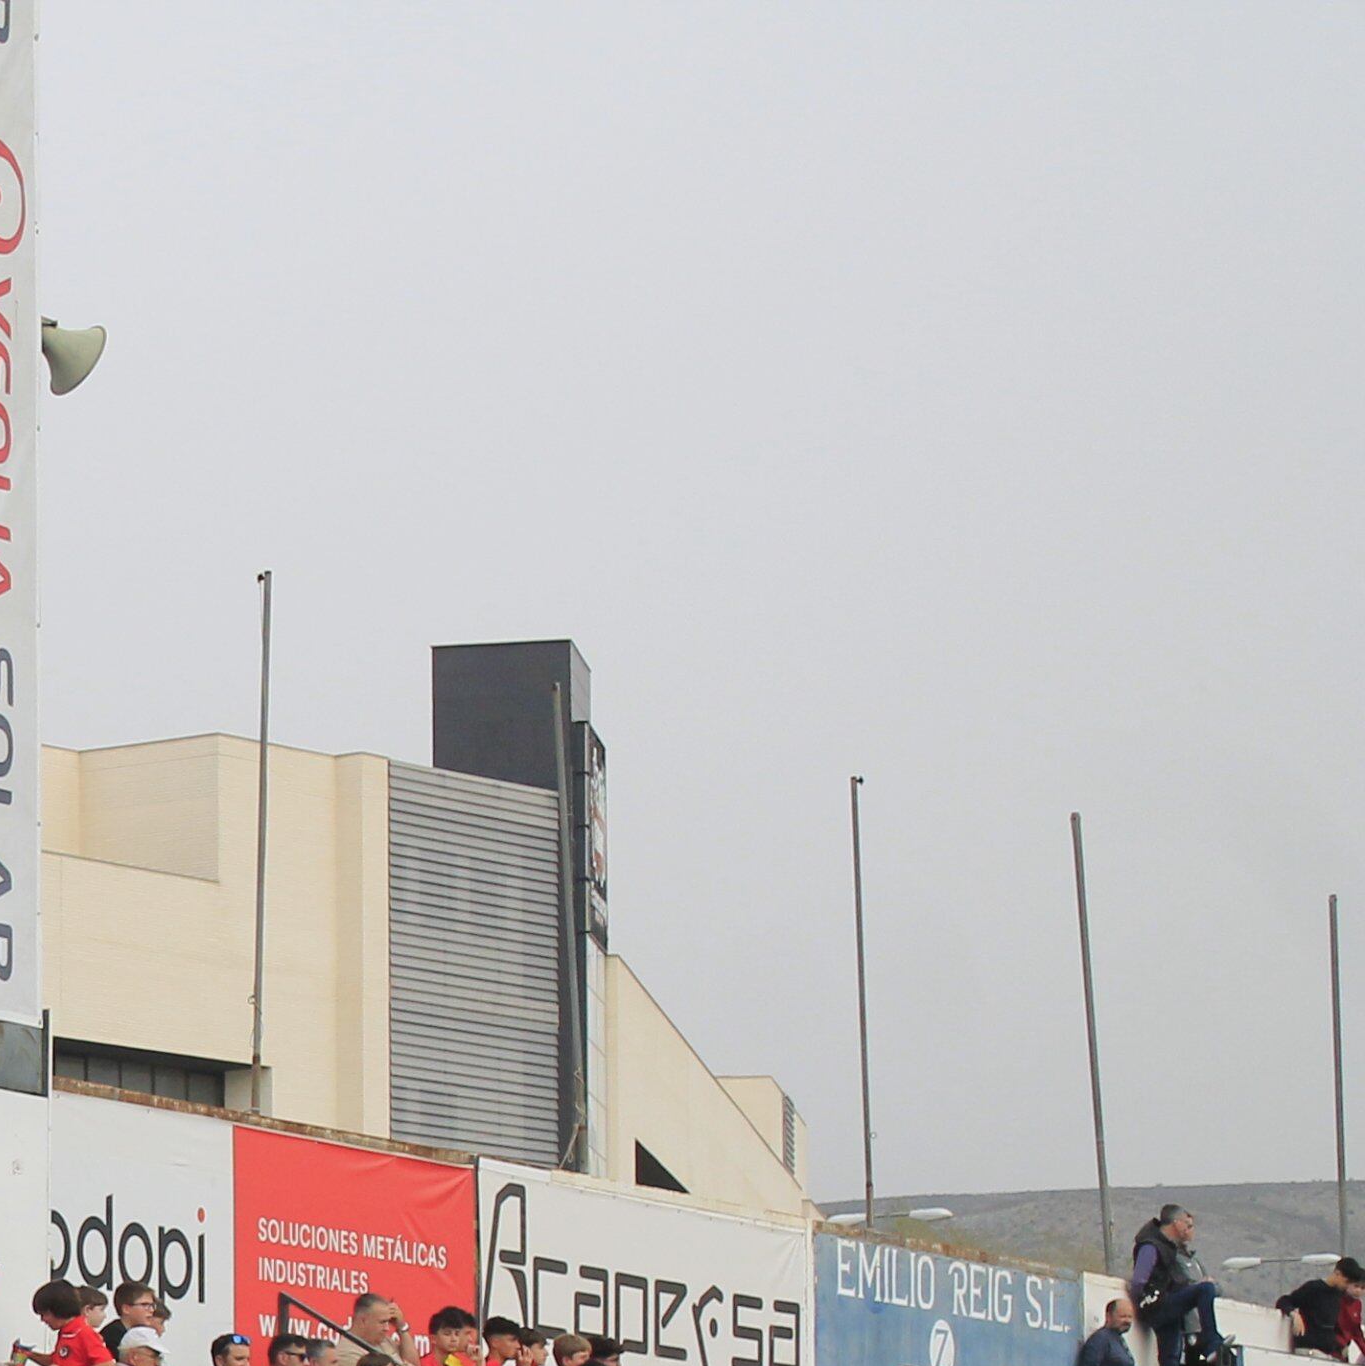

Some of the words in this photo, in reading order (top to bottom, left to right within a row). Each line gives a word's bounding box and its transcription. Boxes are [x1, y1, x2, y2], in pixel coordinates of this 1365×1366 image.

[258, 1217, 359, 1255] SOLUCIONES
[363, 1234, 448, 1270] METÁLICAS
[258, 1257, 369, 1295] INDUSTRIALES
[836, 1238, 936, 1310] EMILIO
[948, 1261, 1013, 1324] REIG
[1025, 1275, 1071, 1333] S.L.
